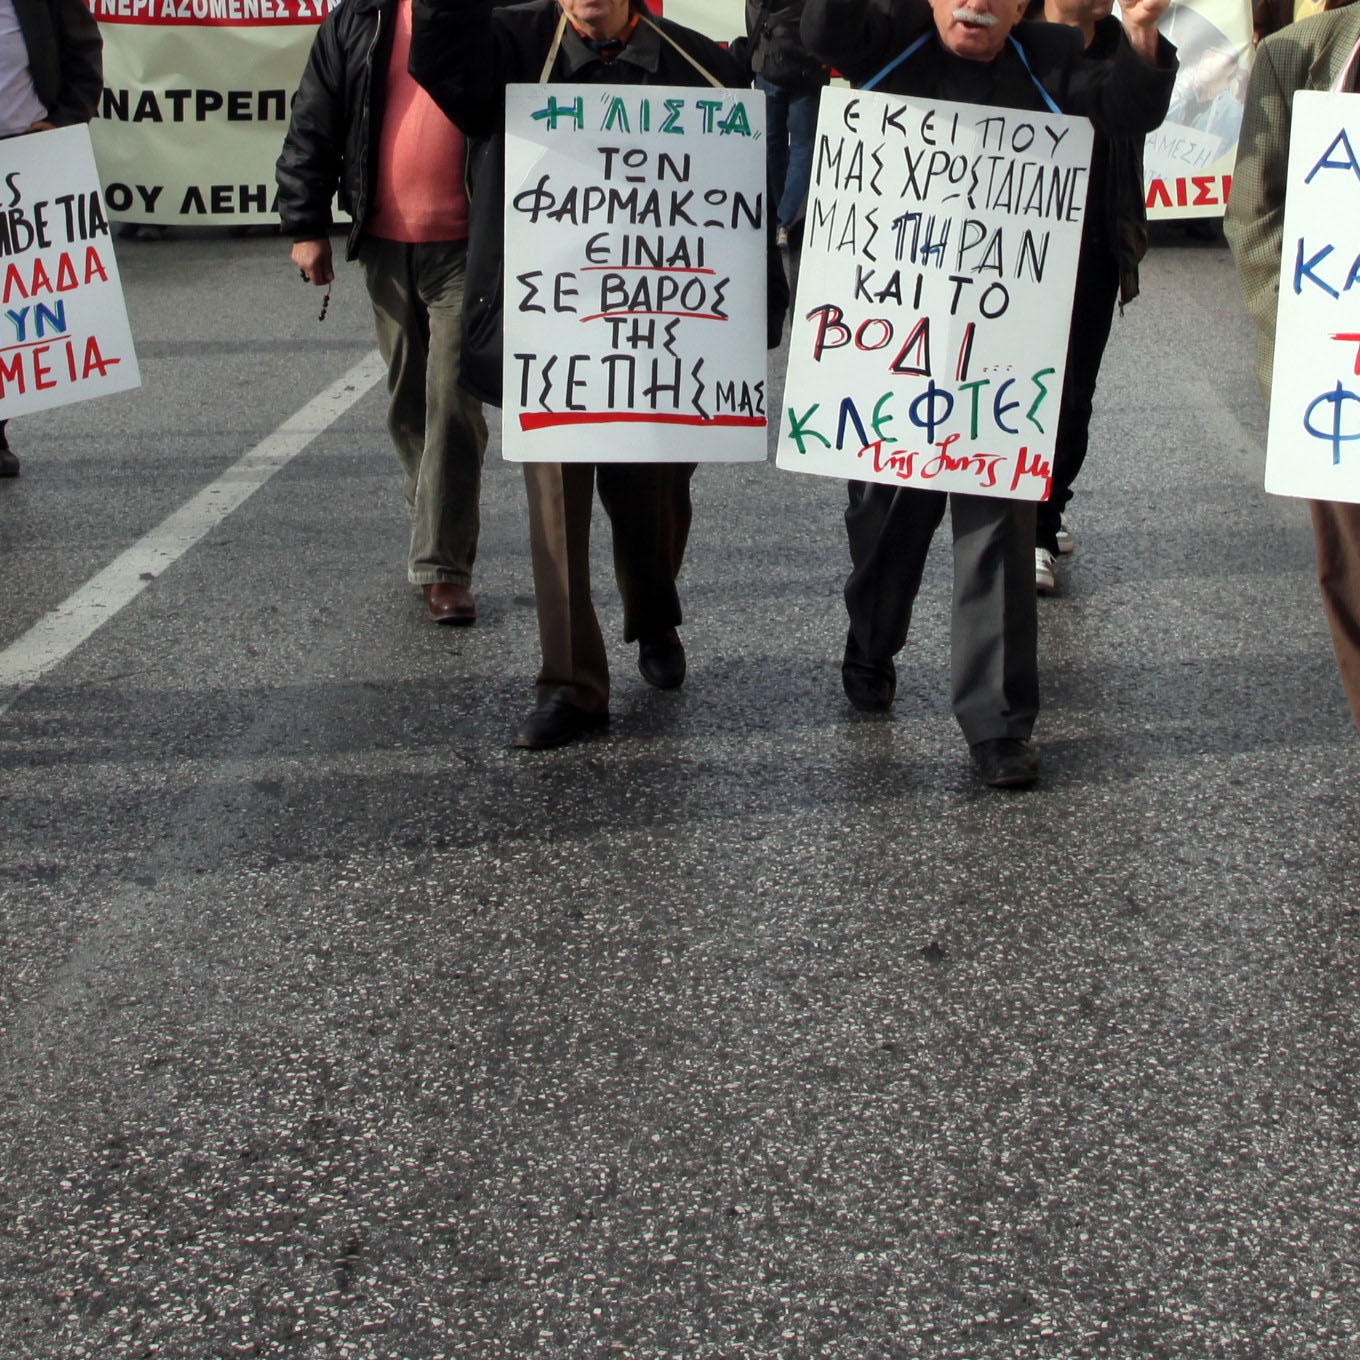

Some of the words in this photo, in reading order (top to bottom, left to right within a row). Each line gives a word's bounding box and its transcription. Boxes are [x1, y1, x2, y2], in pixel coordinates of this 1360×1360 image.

[96, 88, 298, 122] ΝΑΤΡΕΠ
[530, 95, 584, 132] Η
[597, 147, 690, 183] ΤΩΝ
[816, 134, 886, 197] ΜΑΣ
[513, 174, 762, 230] ΦΑΡΜΑΚΩΝ
[585, 232, 705, 268] ΕΙΝΑΙ
[809, 197, 879, 262] ΜΑΣ
[891, 211, 1050, 283] ΠΗΡΑΝ
[515, 271, 579, 314] ΣΕ
[600, 273, 730, 319] ΒΑΡΟΣ
[854, 264, 923, 310] ΚΑΙ
[948, 275, 1010, 319] ΤΟ
[604, 317, 680, 357] ΤΗΣ
[513, 354, 715, 420] ΤΣΕΠΗΣ
[716, 380, 765, 416] ΜΑΣ
[787, 367, 1056, 453] ΚΛΕΦΤΕΣ
